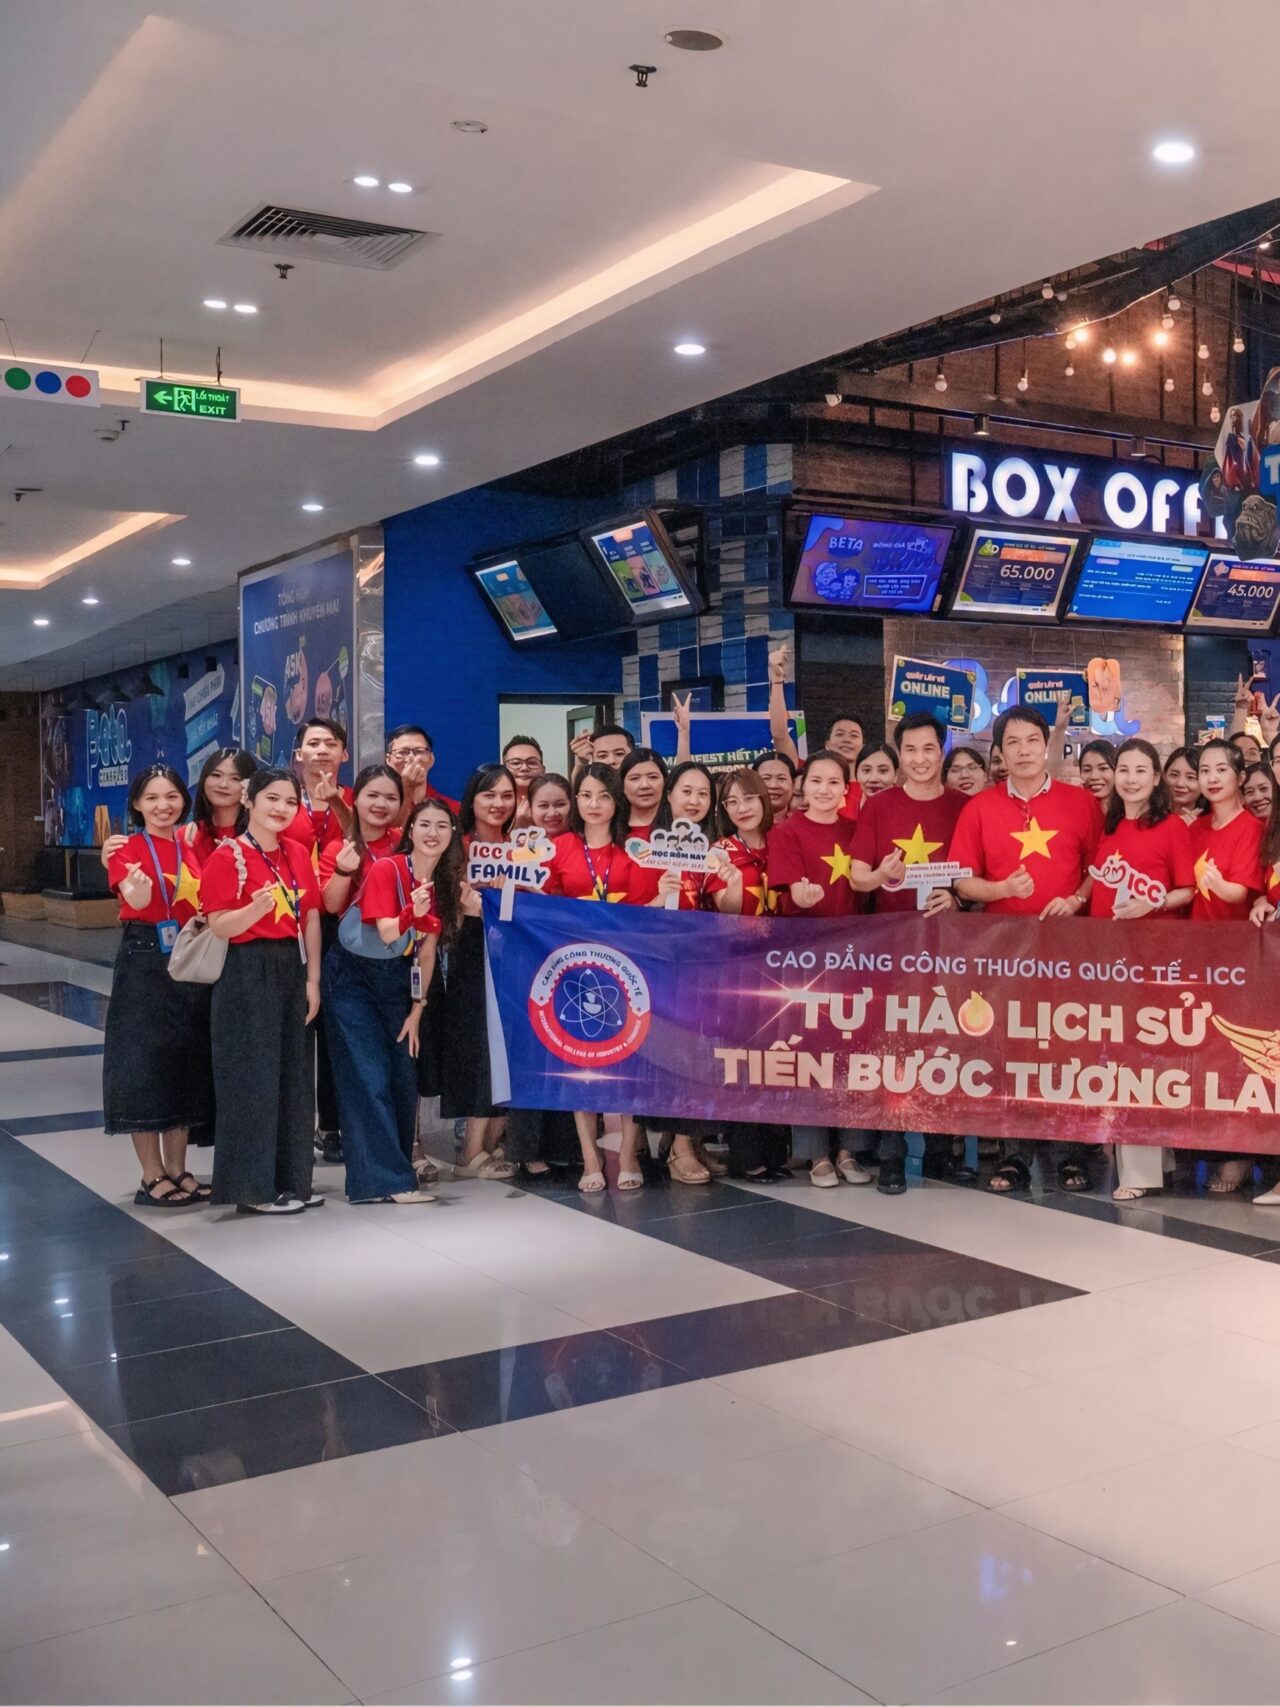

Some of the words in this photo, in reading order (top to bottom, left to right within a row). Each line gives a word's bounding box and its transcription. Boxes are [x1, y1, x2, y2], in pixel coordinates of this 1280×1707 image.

[200, 405, 226, 415] EXIT
[951, 452, 1081, 524] BOX
[829, 536, 864, 551] BETA
[1000, 564, 1055, 581] 65.000
[1227, 583, 1274, 599] 45.000
[900, 680, 950, 699] ONLINE
[727, 748, 750, 762] HẾT
[473, 845, 503, 860] ICC
[470, 863, 547, 885] FAMILY
[1127, 873, 1162, 903] ICC
[564, 950, 587, 961] CÔNG
[766, 950, 817, 968] CAO
[824, 944, 893, 971] ĐẲNG
[900, 951, 967, 974] CÔNG
[974, 957, 1071, 979] THƯƠNG
[1078, 957, 1144, 983] QUỐC
[1151, 959, 1182, 984] TẾ
[1206, 967, 1246, 985] ICC
[1007, 1000, 1124, 1049] LỊCH
[1135, 992, 1212, 1047] SỬ
[714, 1034, 834, 1090] TIẾN
[848, 1046, 994, 1098] BƯỚC
[1006, 1058, 1191, 1109] TƯƠNG
